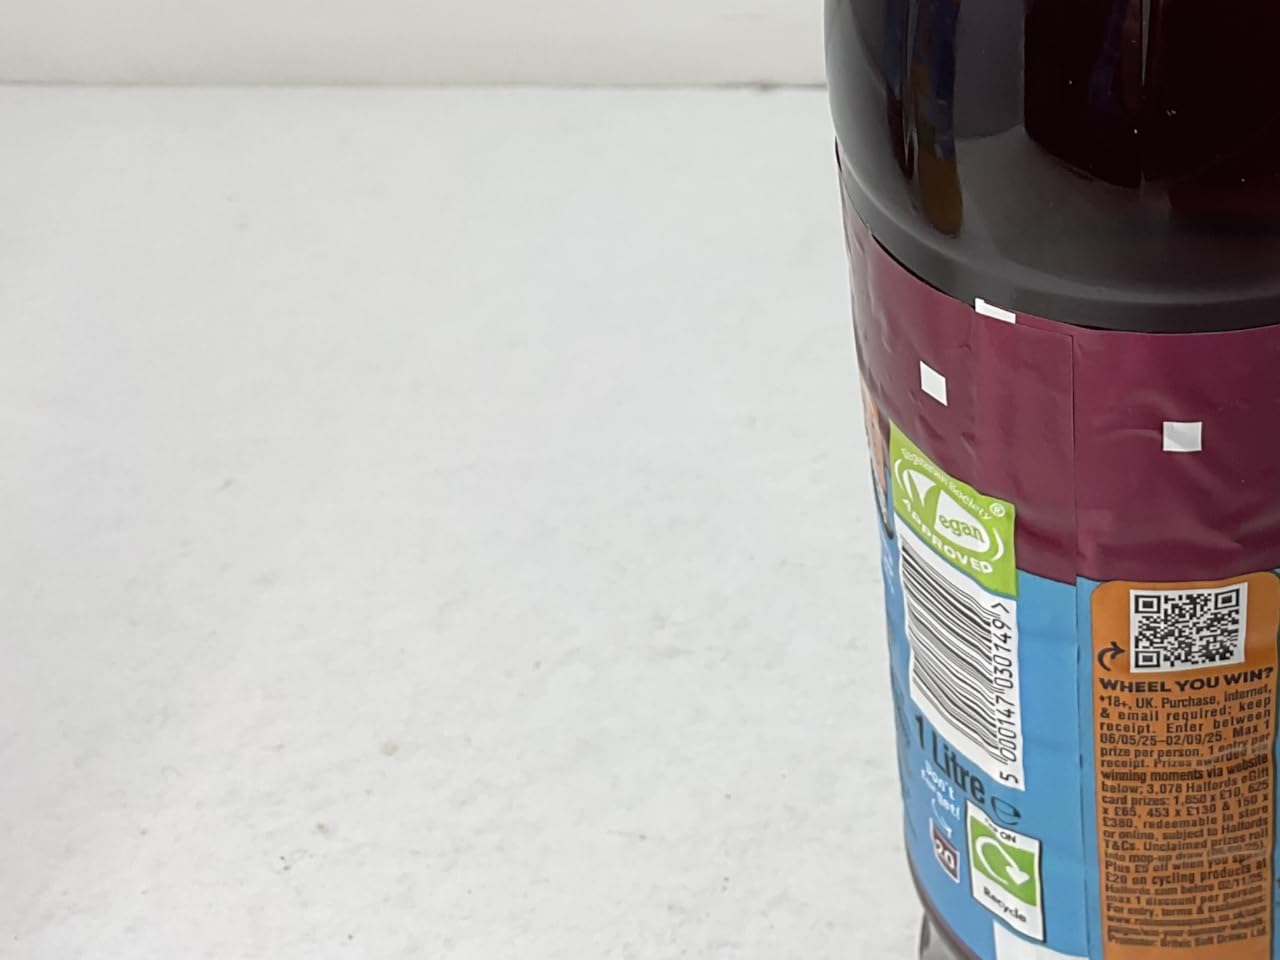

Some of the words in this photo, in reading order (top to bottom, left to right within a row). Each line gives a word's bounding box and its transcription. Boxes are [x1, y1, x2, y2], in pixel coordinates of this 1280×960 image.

[1098, 677, 1172, 693] WHEEL
[1175, 675, 1220, 692] YOU
[1223, 667, 1274, 685] WIN?
[1100, 707, 1110, 719] &
[1118, 710, 1159, 721] email
[1239, 696, 1271, 712] keep
[1166, 720, 1203, 734] Enter
[1213, 709, 1271, 729] between
[1232, 723, 1258, 738] Max
[915, 714, 925, 750] 1
[931, 729, 985, 805] Litre
[1101, 746, 1131, 757] prize
[1134, 749, 1154, 759] per
[1000, 771, 1019, 784] 5
[1101, 769, 1147, 784] winning
[1150, 769, 1204, 782] moments
[1207, 765, 1223, 778] via
